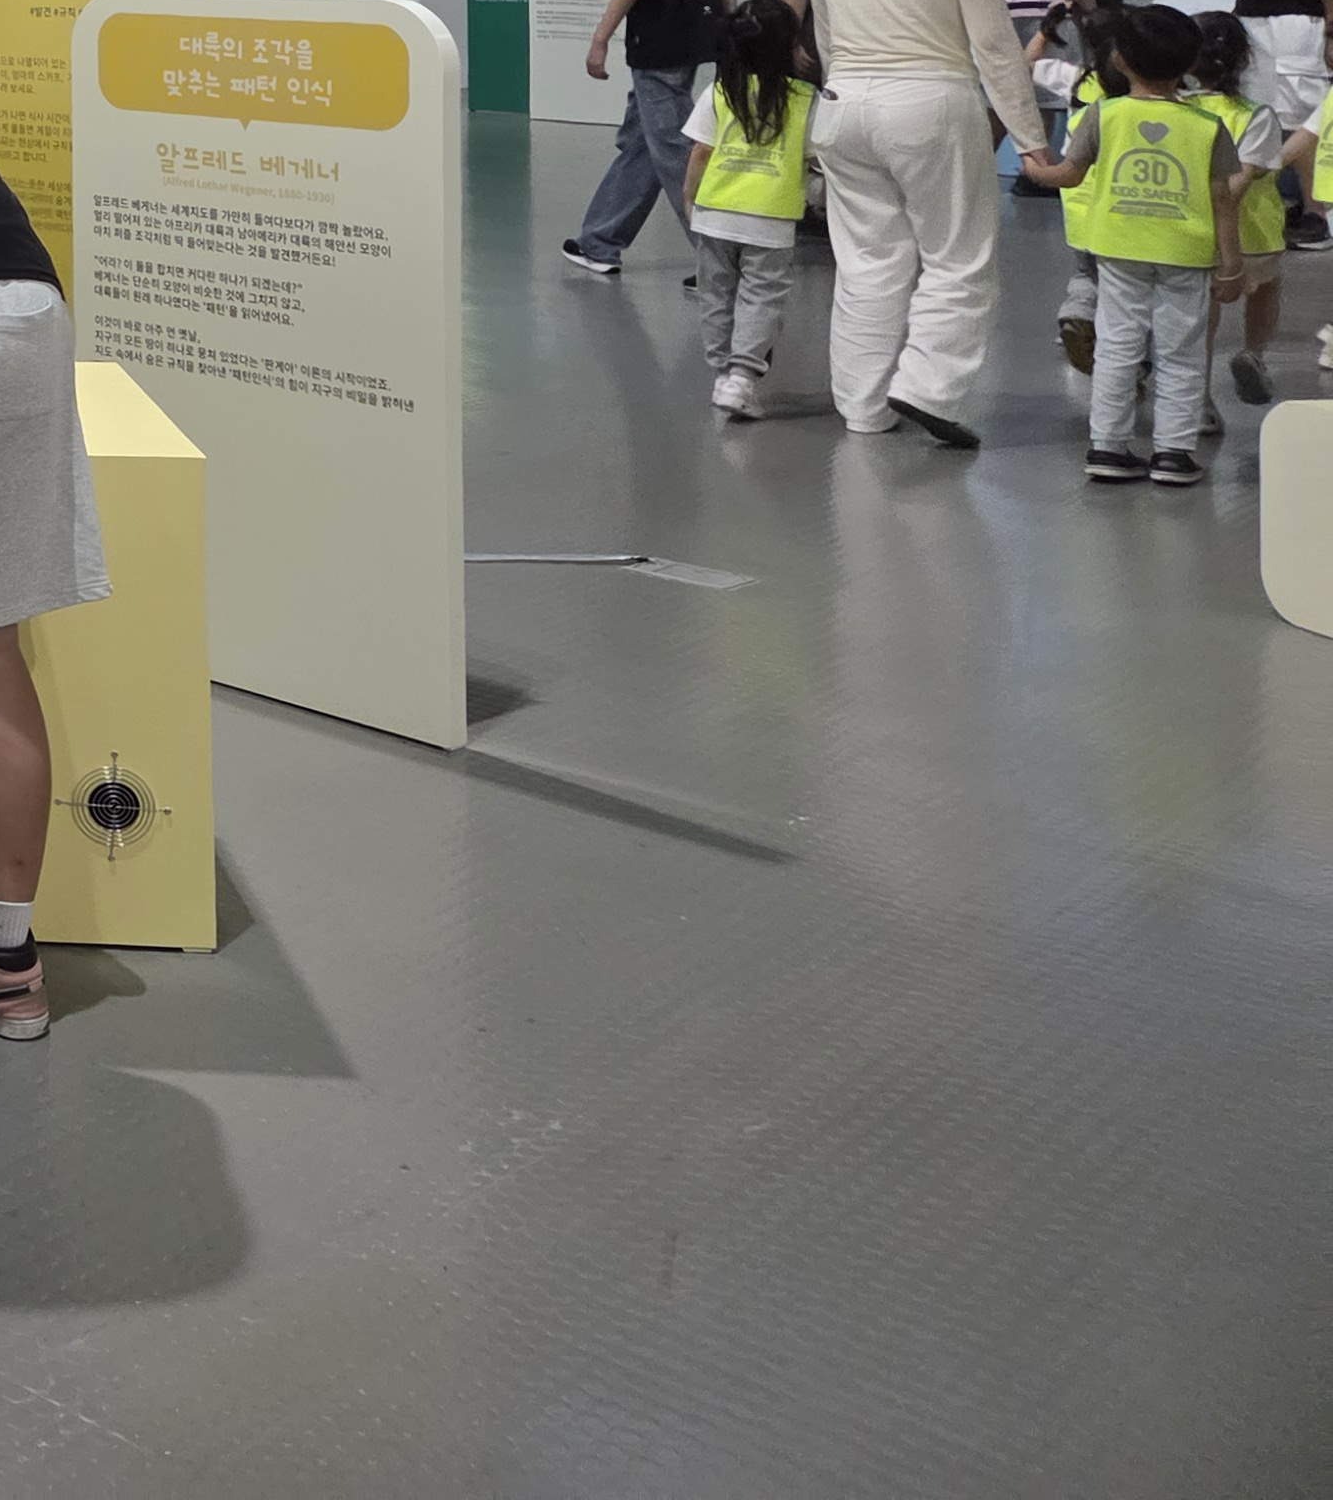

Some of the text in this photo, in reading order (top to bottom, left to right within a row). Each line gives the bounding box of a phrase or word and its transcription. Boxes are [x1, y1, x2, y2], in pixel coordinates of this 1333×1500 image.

[50, 58, 66, 69] 있는
[179, 31, 314, 70] 대륙의 조각을
[162, 68, 333, 107] 맞추는 패턴 인식
[156, 142, 339, 182] 알프레드 베게너
[1133, 158, 1170, 186] 30
[162, 174, 336, 205] (Alfred Lothar Wegener, 1880-1930)
[1110, 185, 1189, 204] KIDS SAFETY
[93, 194, 389, 241] 알프레드 베게너는 세계지도를 가만히 들여다보다가 깜짝 놀랐어요.
[93, 209, 392, 259] 멀리 떨어져 있는 아프리카 대륙과 남아메리카 대륙의 해안선 모양이
[93, 224, 111, 238] 마치
[113, 227, 132, 241] 퍼즐
[134, 230, 172, 246] 조각처럼
[174, 235, 184, 247] 딱
[247, 244, 267, 259] 것을
[94, 270, 306, 314] 베게너는 단순히 모양이 비슷한 것에 그치지 않고,
[123, 258, 133, 271] 이
[136, 260, 154, 274] 둘을
[157, 262, 184, 279] 합치면
[187, 267, 216, 283] 커다란
[219, 272, 248, 287] 하나가
[94, 284, 131, 300] 대륙들이
[133, 289, 151, 304] 원래
[153, 293, 201, 313] 하나였다는
[241, 306, 295, 327] 읽어냈어요.
[94, 314, 122, 330] 이것이
[123, 319, 142, 333] 바로
[144, 323, 164, 337] 아주
[94, 329, 122, 345] 지구의
[124, 334, 142, 348] 모든
[144, 337, 164, 352] 땅이
[166, 341, 195, 358] 하나로
[197, 345, 217, 361] 뭉쳐
[219, 350, 259, 369] 있었다는
[300, 364, 332, 382] 이론의
[335, 370, 392, 392] 시작이었죠.
[94, 344, 113, 358] 지도
[115, 347, 143, 364] 속에서
[145, 351, 164, 368] 숨은
[167, 356, 195, 373] 규칙을
[197, 361, 227, 379] 찾아낸
[288, 378, 309, 394] 힘이
[311, 382, 343, 399] 지구의
[345, 389, 378, 407] 비밀을
[381, 395, 415, 413] 밝혀낸
